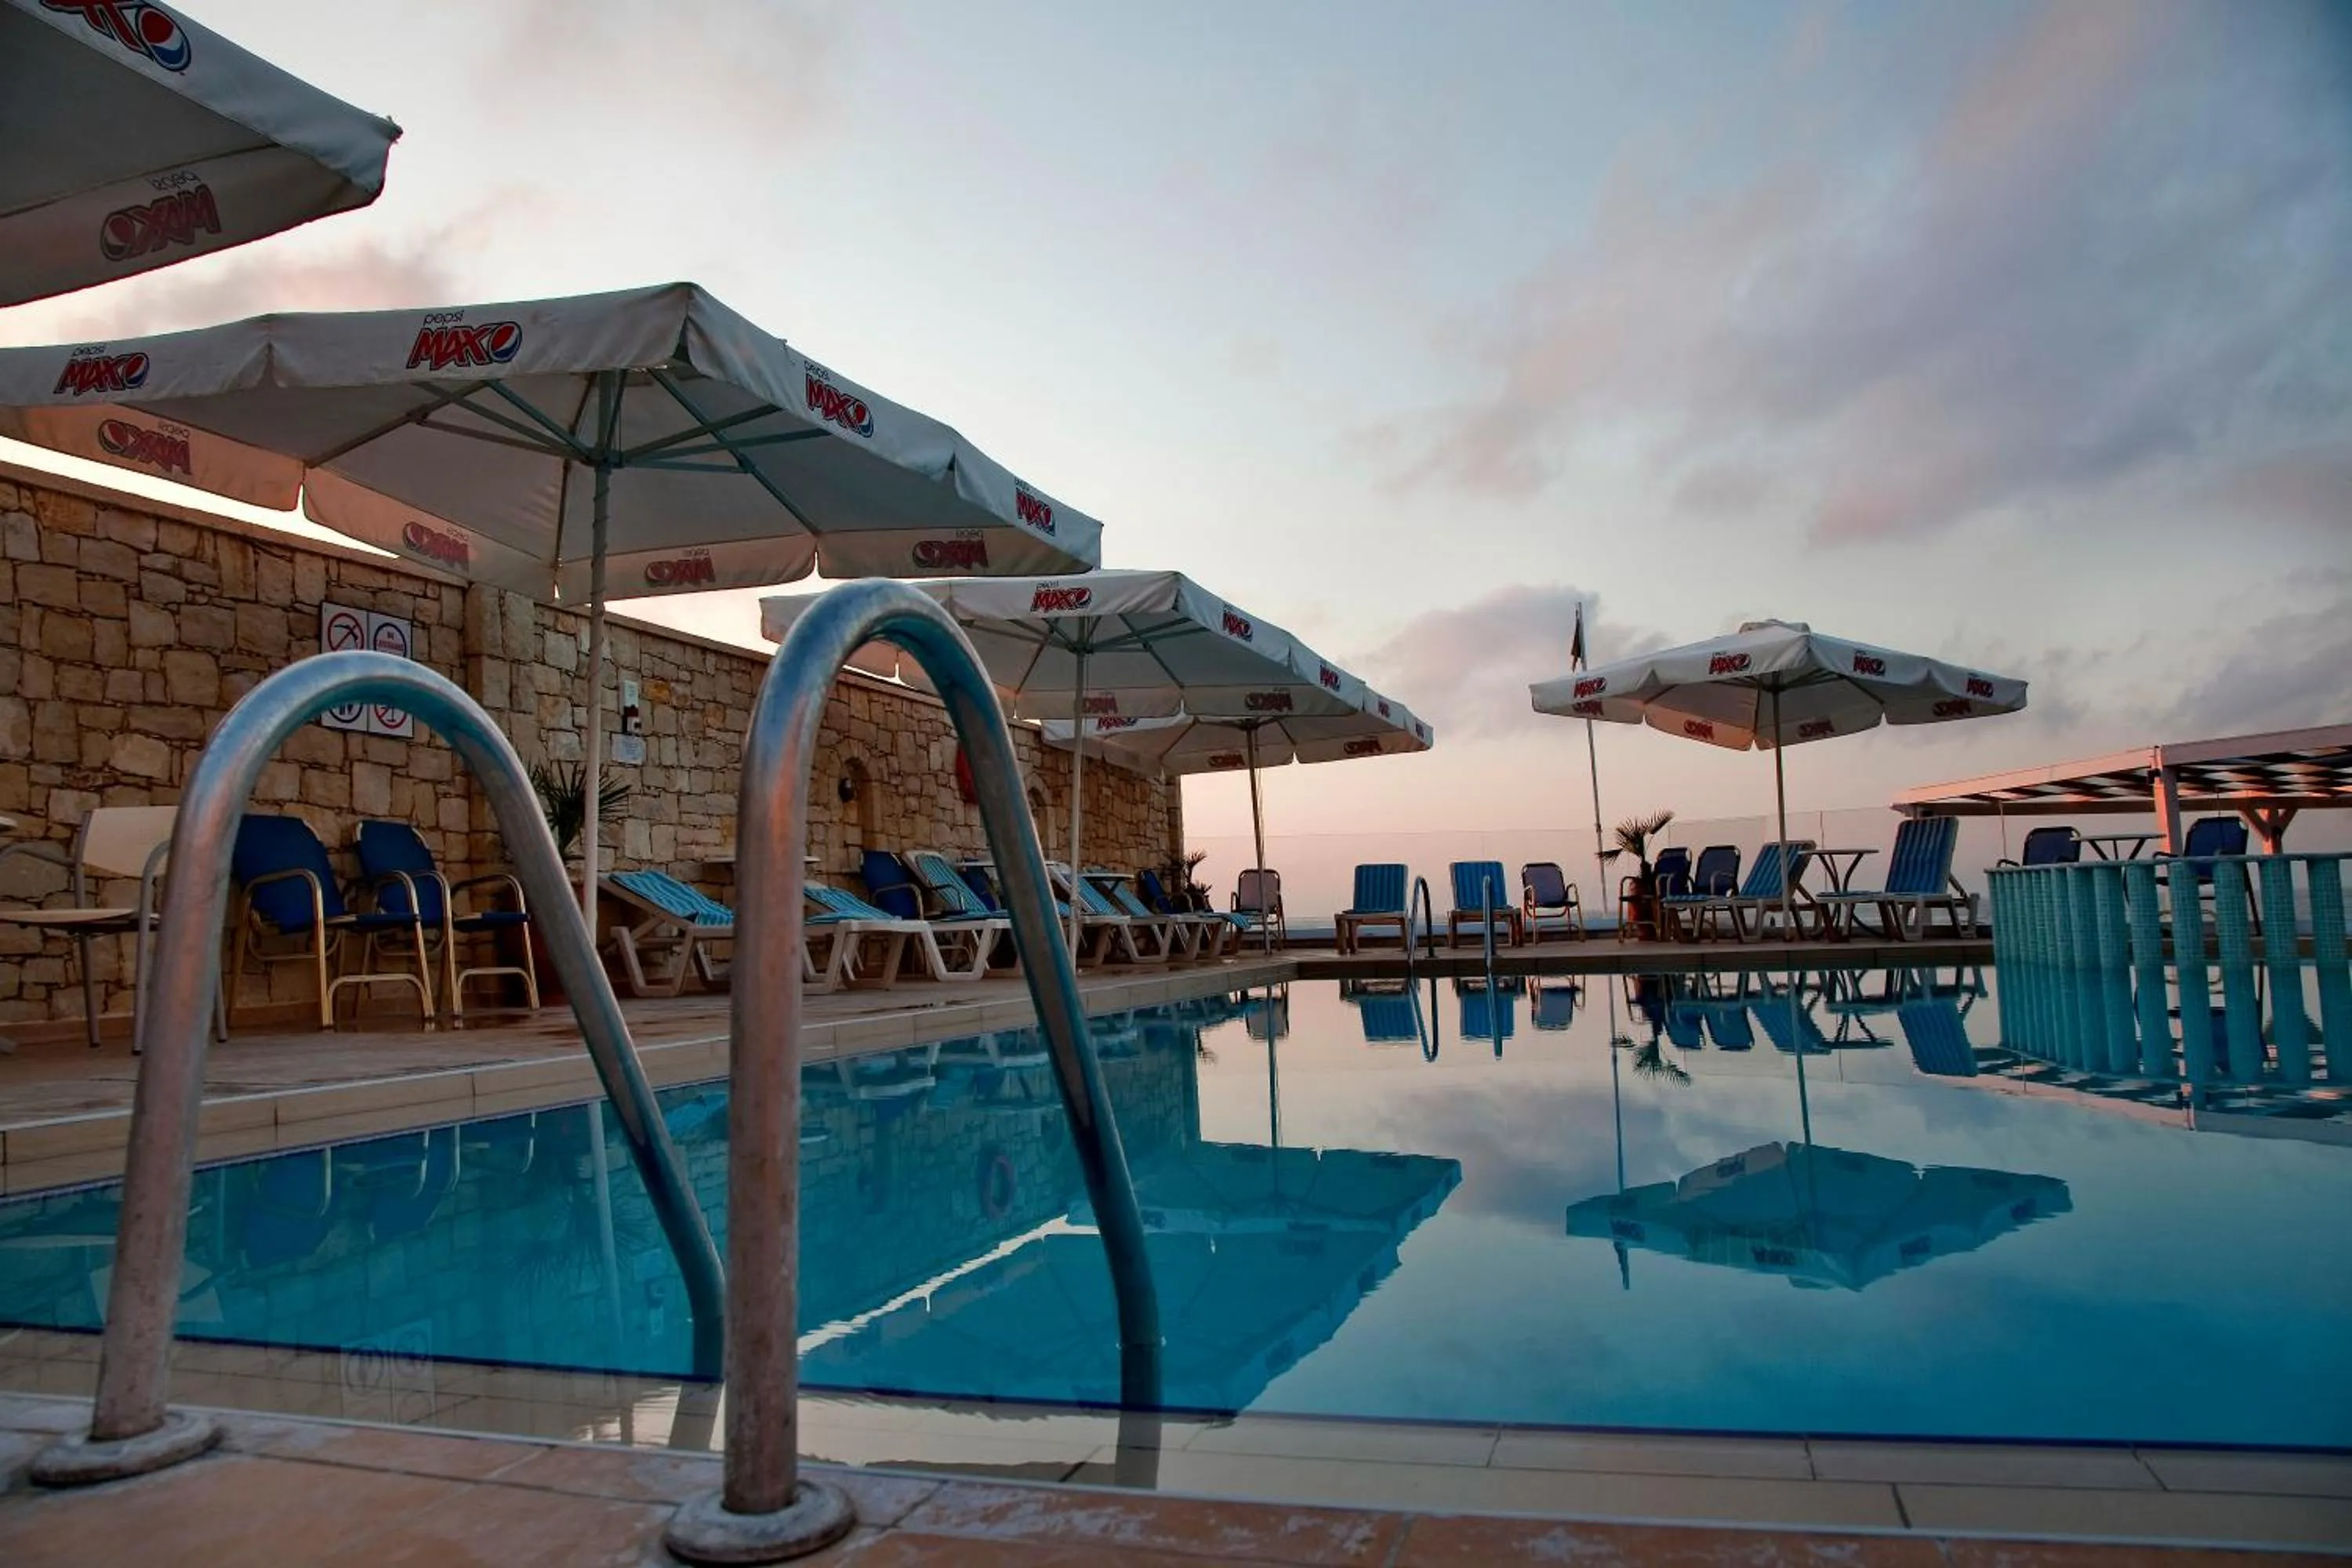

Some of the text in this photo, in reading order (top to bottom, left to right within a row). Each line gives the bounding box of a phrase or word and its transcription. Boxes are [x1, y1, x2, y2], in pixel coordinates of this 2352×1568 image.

[423, 309, 465, 327] pepsi
[405, 323, 493, 371] MAX
[53, 354, 129, 397] MAX
[805, 372, 860, 434] MAX
[1015, 487, 1047, 533] MAX
[1029, 589, 1078, 613] MAX
